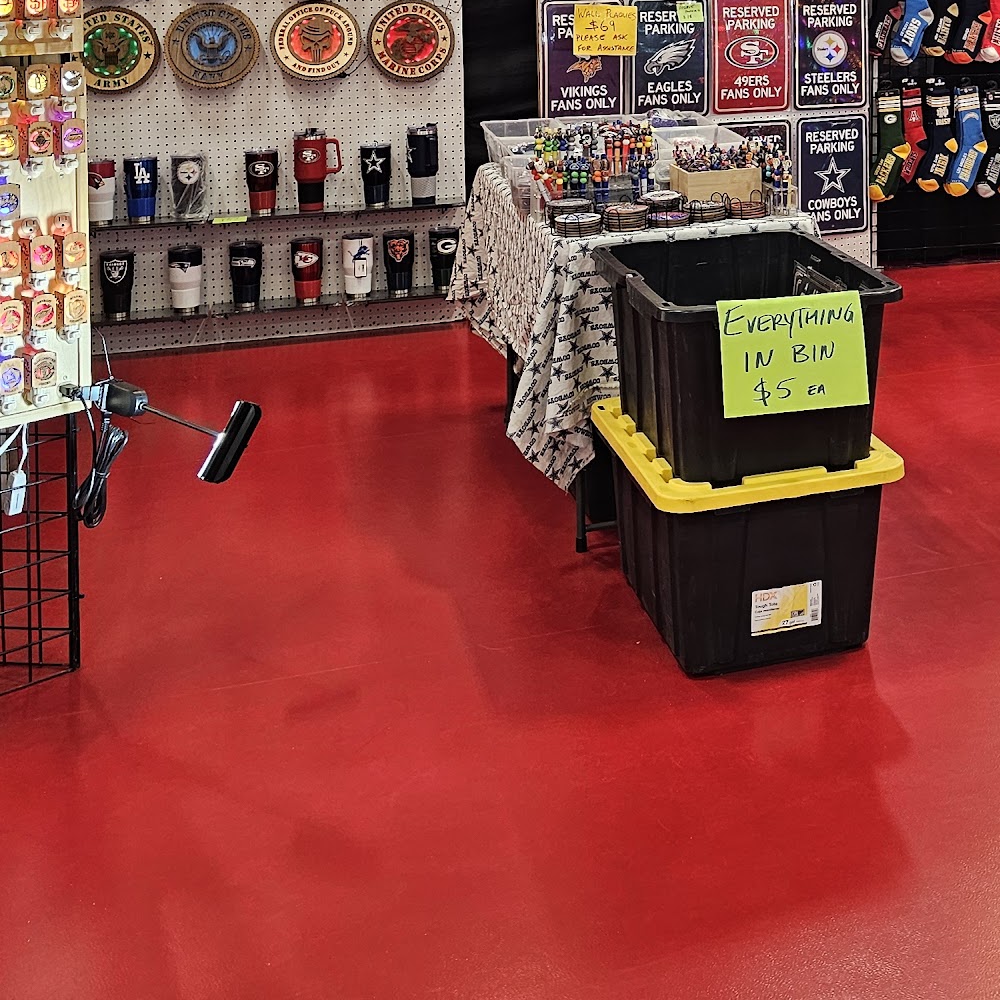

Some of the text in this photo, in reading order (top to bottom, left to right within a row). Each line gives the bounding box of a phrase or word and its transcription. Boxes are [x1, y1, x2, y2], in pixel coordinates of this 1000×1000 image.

[578, 8, 636, 20] WALL PLAQUES
[722, 6, 780, 18] RESERVED
[802, 4, 857, 16] RESERVED
[375, 5, 446, 34] UNITED STATES
[585, 20, 616, 32] $69
[727, 19, 776, 30] PARKING
[808, 16, 853, 28] PARKING
[289, 6, 313, 21] OFFICE
[325, 7, 342, 23] FUCK
[342, 20, 353, 47] AROUND
[644, 22, 695, 35] PARKING
[901, 18, 922, 48] LIONS
[576, 34, 605, 42] PLEASE
[740, 40, 769, 65] SF
[292, 60, 341, 74] AND FIND OUT
[377, 47, 447, 76] MARINE CORPS
[94, 77, 129, 88] ARMY
[734, 75, 770, 88] 49ERS
[804, 71, 857, 84] STEELERS
[560, 85, 608, 98] VIKINGS
[647, 80, 693, 94] EAGLES
[720, 86, 782, 100] FANS ONLY
[800, 83, 860, 96] FANS ONLY
[550, 97, 617, 112] FANS ONLY
[638, 92, 702, 106] FANS ONLY
[805, 128, 859, 143] RESERVED
[810, 141, 855, 154] PARKING
[134, 162, 151, 184] LA
[808, 196, 858, 210] COWBOYS
[834, 208, 862, 220] ONLY
[724, 302, 854, 338] EVERYTHING
[745, 341, 835, 372] IN BIN
[754, 378, 826, 406] $5 EA
[755, 592, 777, 602] HDX
